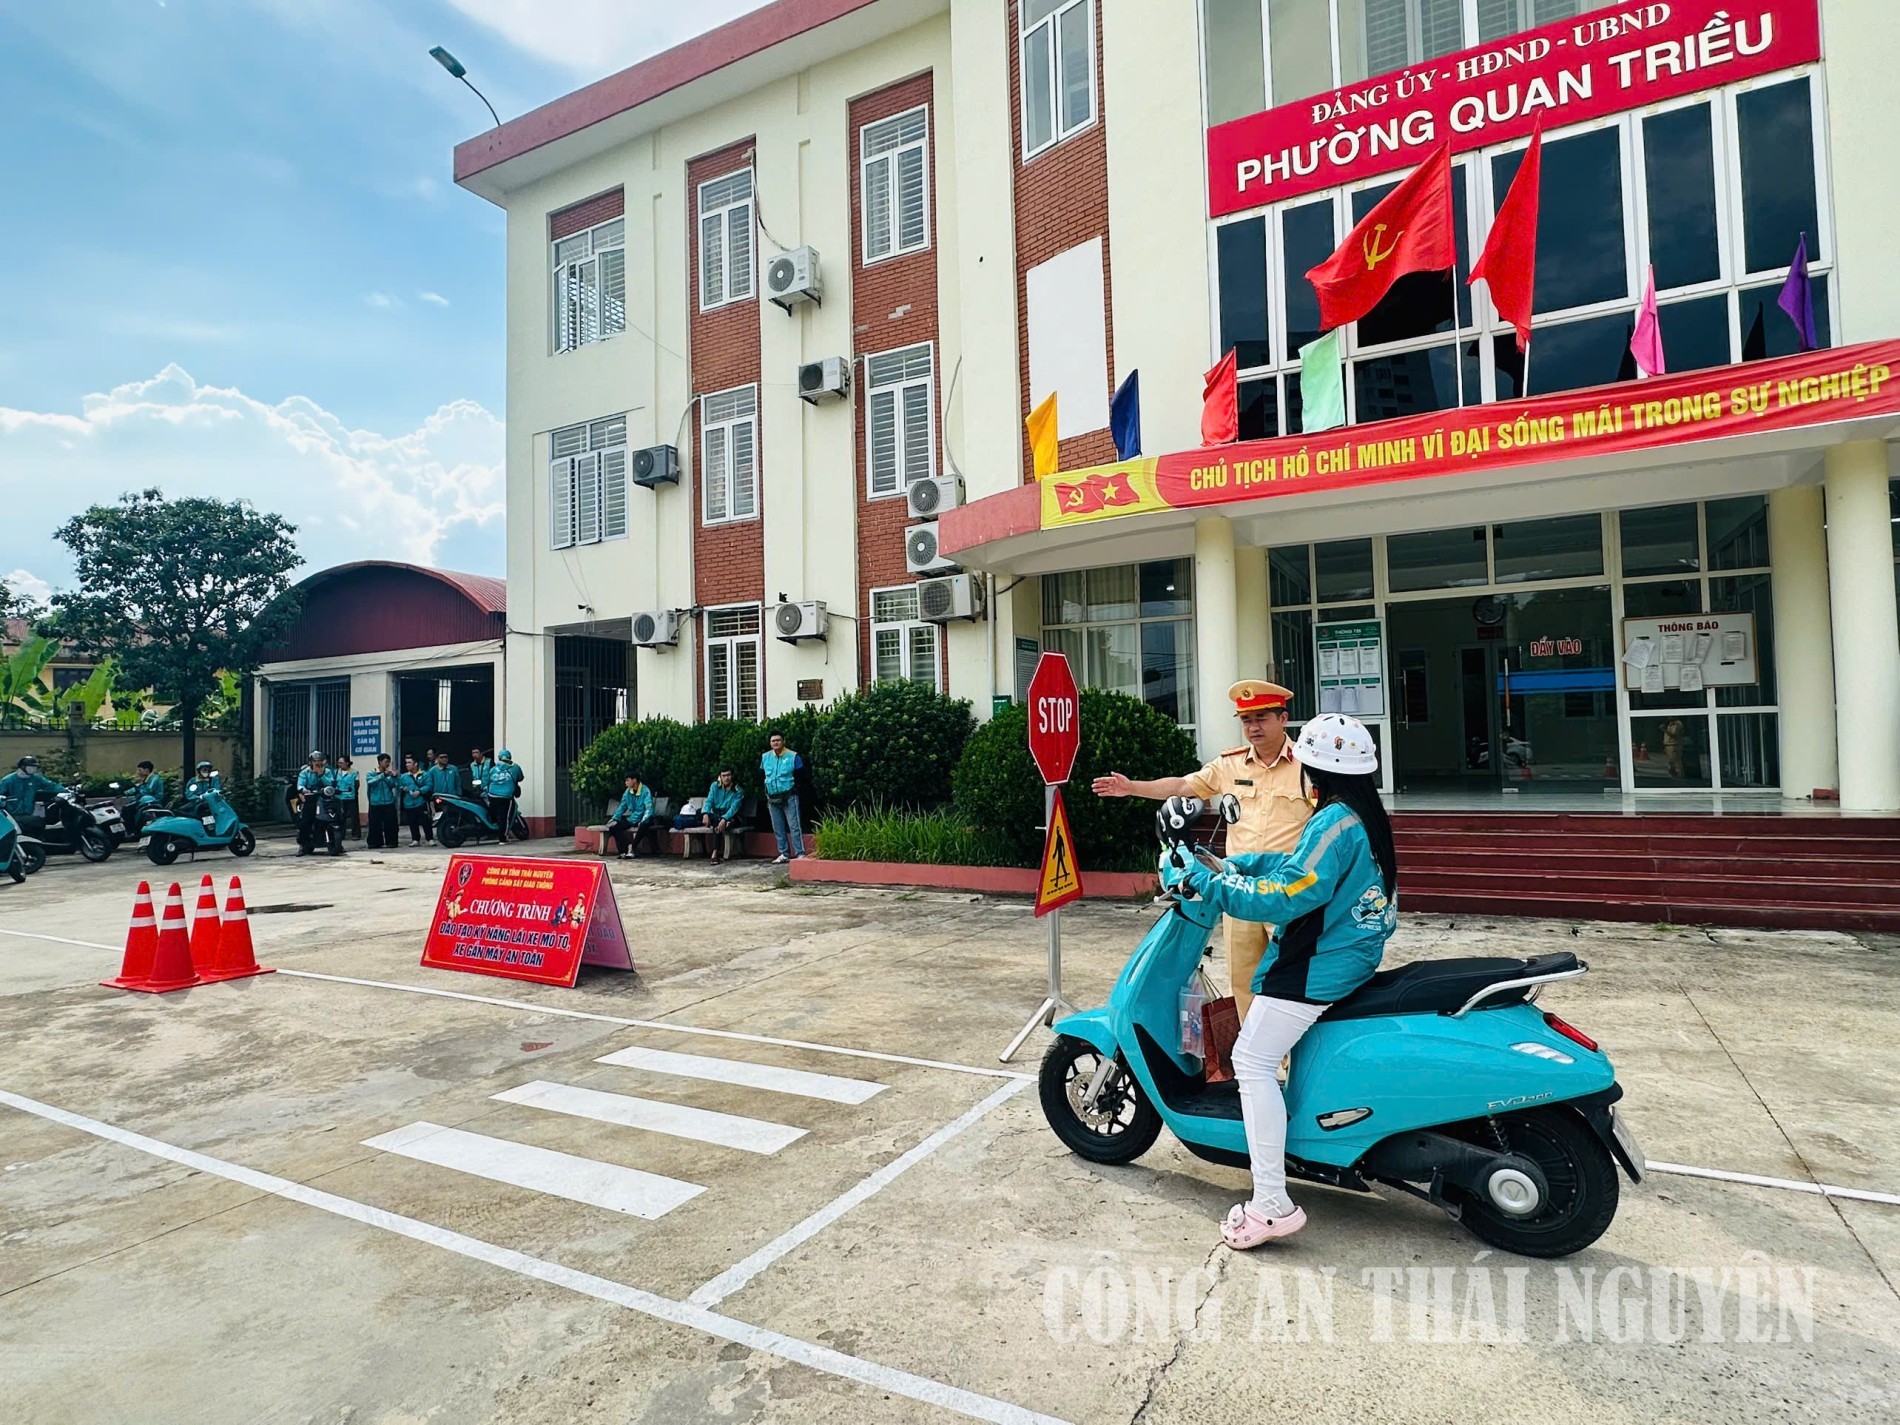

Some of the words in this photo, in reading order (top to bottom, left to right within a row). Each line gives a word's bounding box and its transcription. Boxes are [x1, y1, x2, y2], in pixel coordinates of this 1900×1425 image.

[1312, 85, 1389, 125] ĐẢNG
[1396, 70, 1437, 99] ỦY
[1457, 37, 1551, 83] HĐND
[1573, 3, 1671, 47] UBND
[1237, 109, 1435, 193] PHƯỜNG
[1450, 63, 1593, 133] QUAN
[1608, 11, 1774, 89] TRIỀU
[1190, 457, 1228, 491] CHỦ
[1233, 458, 1277, 489] TỊCH
[1283, 445, 1310, 479] HỒ
[1316, 442, 1350, 474] CHÍ
[1357, 438, 1416, 469] MINH
[1421, 429, 1444, 460] VĨ
[1450, 426, 1490, 459] ĐẠI
[1497, 411, 1565, 449] SỐNG
[1573, 402, 1623, 439] MÃI
[1630, 392, 1722, 430] TRONG
[1731, 380, 1772, 416] SỰ
[1778, 363, 1890, 408] NGHIỆP
[1657, 621, 1694, 632] THÔNG
[1696, 620, 1719, 630] BÁO
[1557, 636, 1582, 655] VÀO
[1038, 696, 1073, 733] STOP
[469, 898, 515, 918] CHƯƠNG
[516, 900, 552, 920] TRÌNH
[439, 921, 456, 936] ĐÀO
[457, 922, 473, 940] TẠO
[474, 923, 486, 939] KỸ
[486, 924, 511, 942] NĂNG
[511, 927, 526, 943] LÁI
[526, 931, 539, 946] XE
[540, 930, 556, 948] MÔ
[453, 942, 466, 957] XE
[466, 940, 484, 959] GẮN
[484, 945, 505, 961] MÁY
[505, 949, 519, 965] AN
[519, 949, 545, 968] TOÀN
